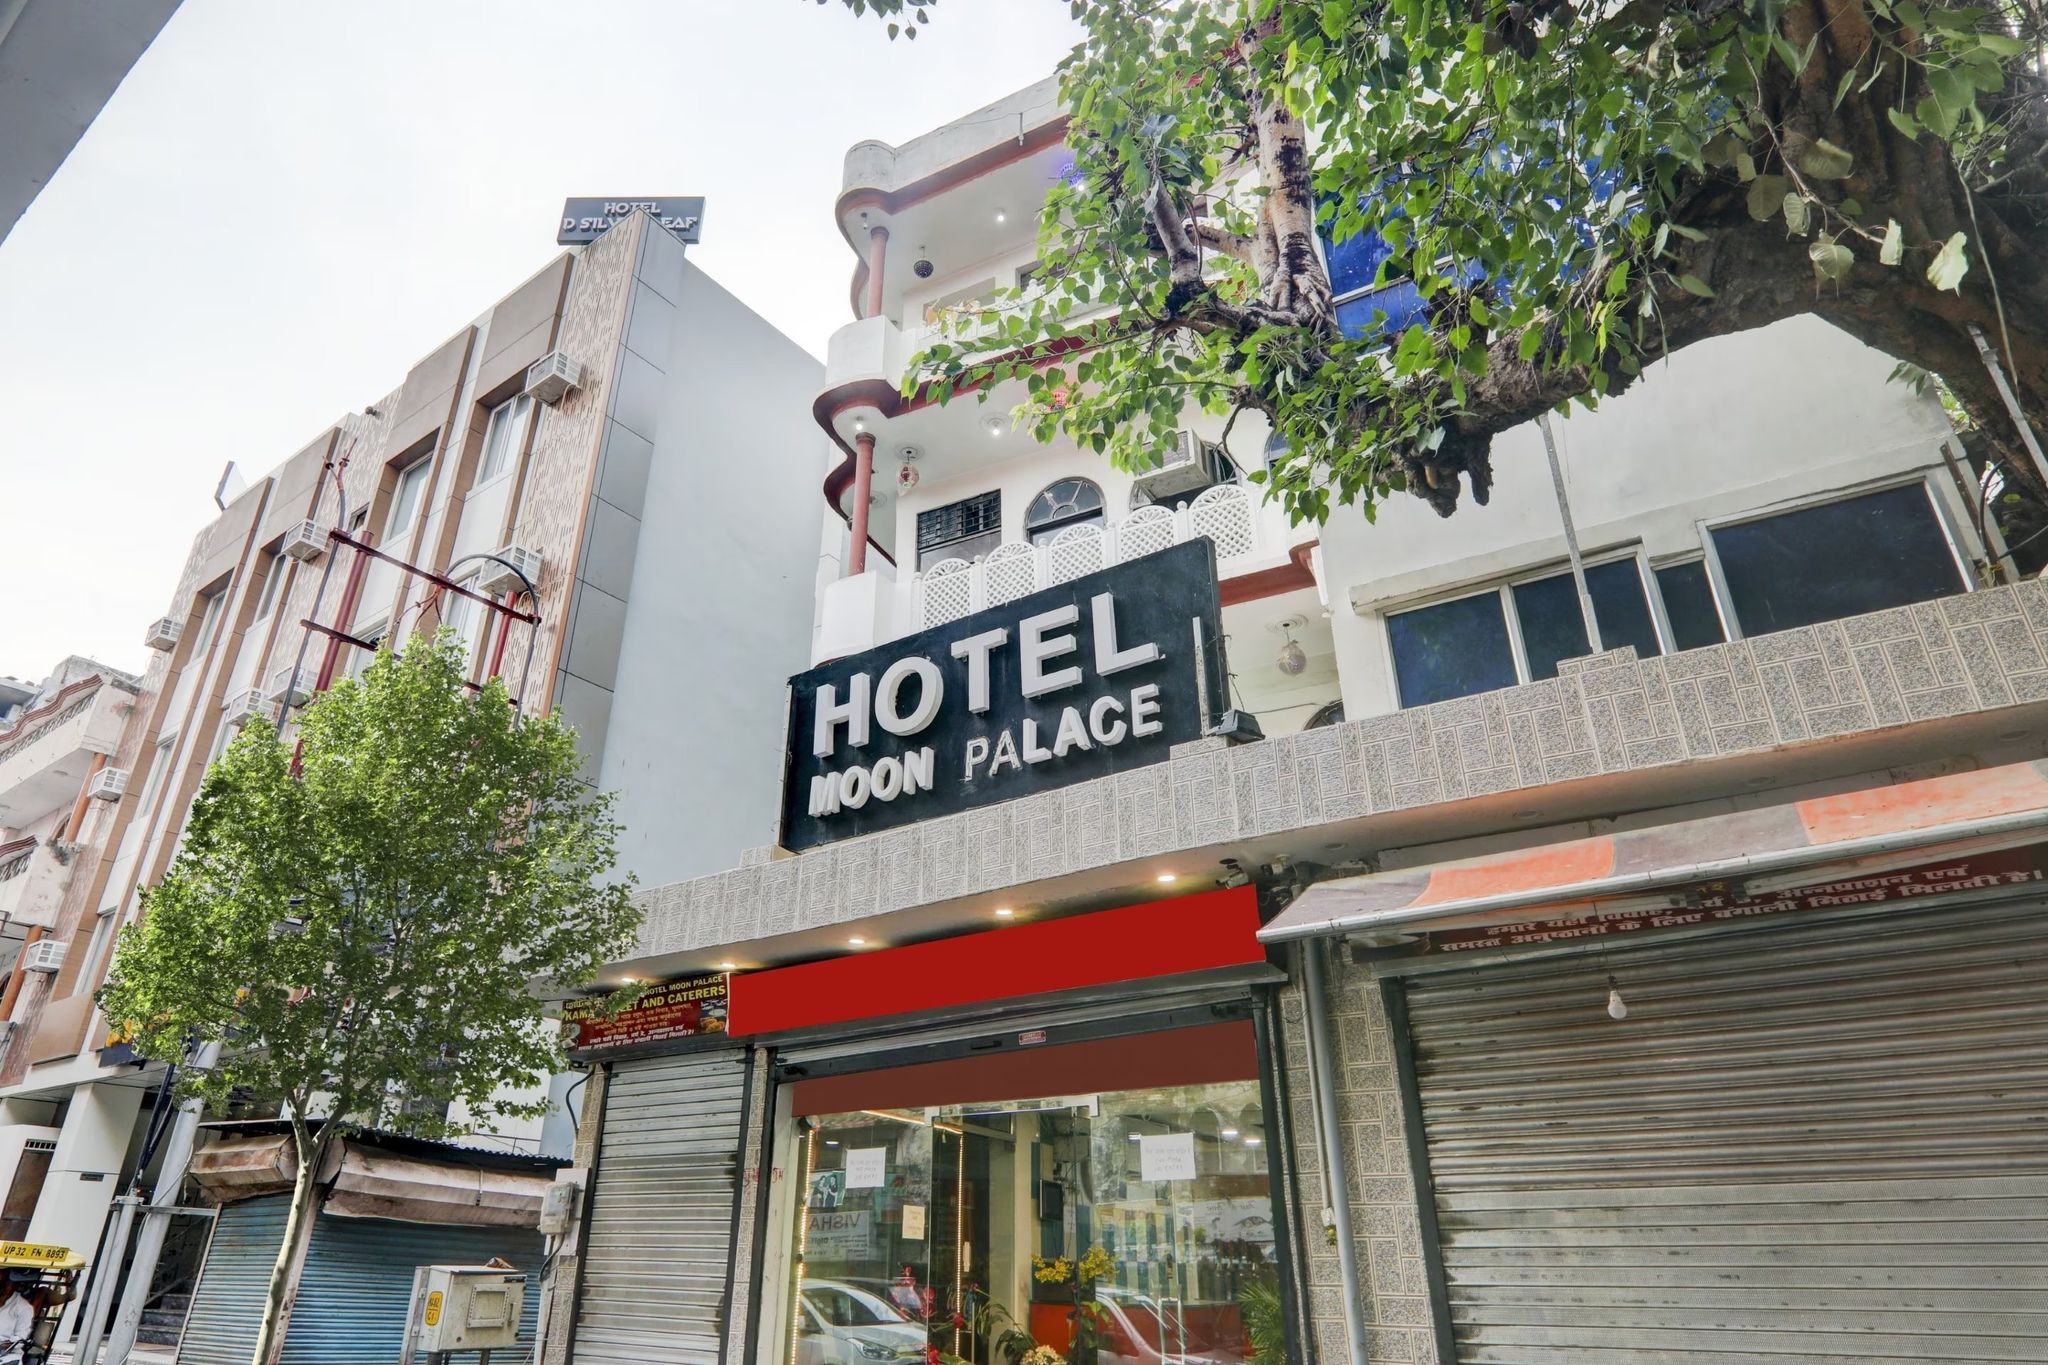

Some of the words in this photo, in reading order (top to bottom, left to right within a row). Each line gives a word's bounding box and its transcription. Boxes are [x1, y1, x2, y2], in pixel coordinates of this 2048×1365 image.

[814, 592, 1163, 759] HOTEL
[808, 747, 934, 817] MOON
[963, 683, 1163, 781] PALACE
[1921, 864, 1968, 880] एवं
[1615, 919, 1643, 931] के
[1650, 910, 1704, 929] लिए
[1900, 874, 2000, 898] मिलती
[669, 982, 691, 991] MOON
[693, 975, 723, 987] PALACE
[642, 996, 664, 1009] AND
[668, 985, 726, 1004] CATERERS
[31, 1248, 42, 1257] FN
